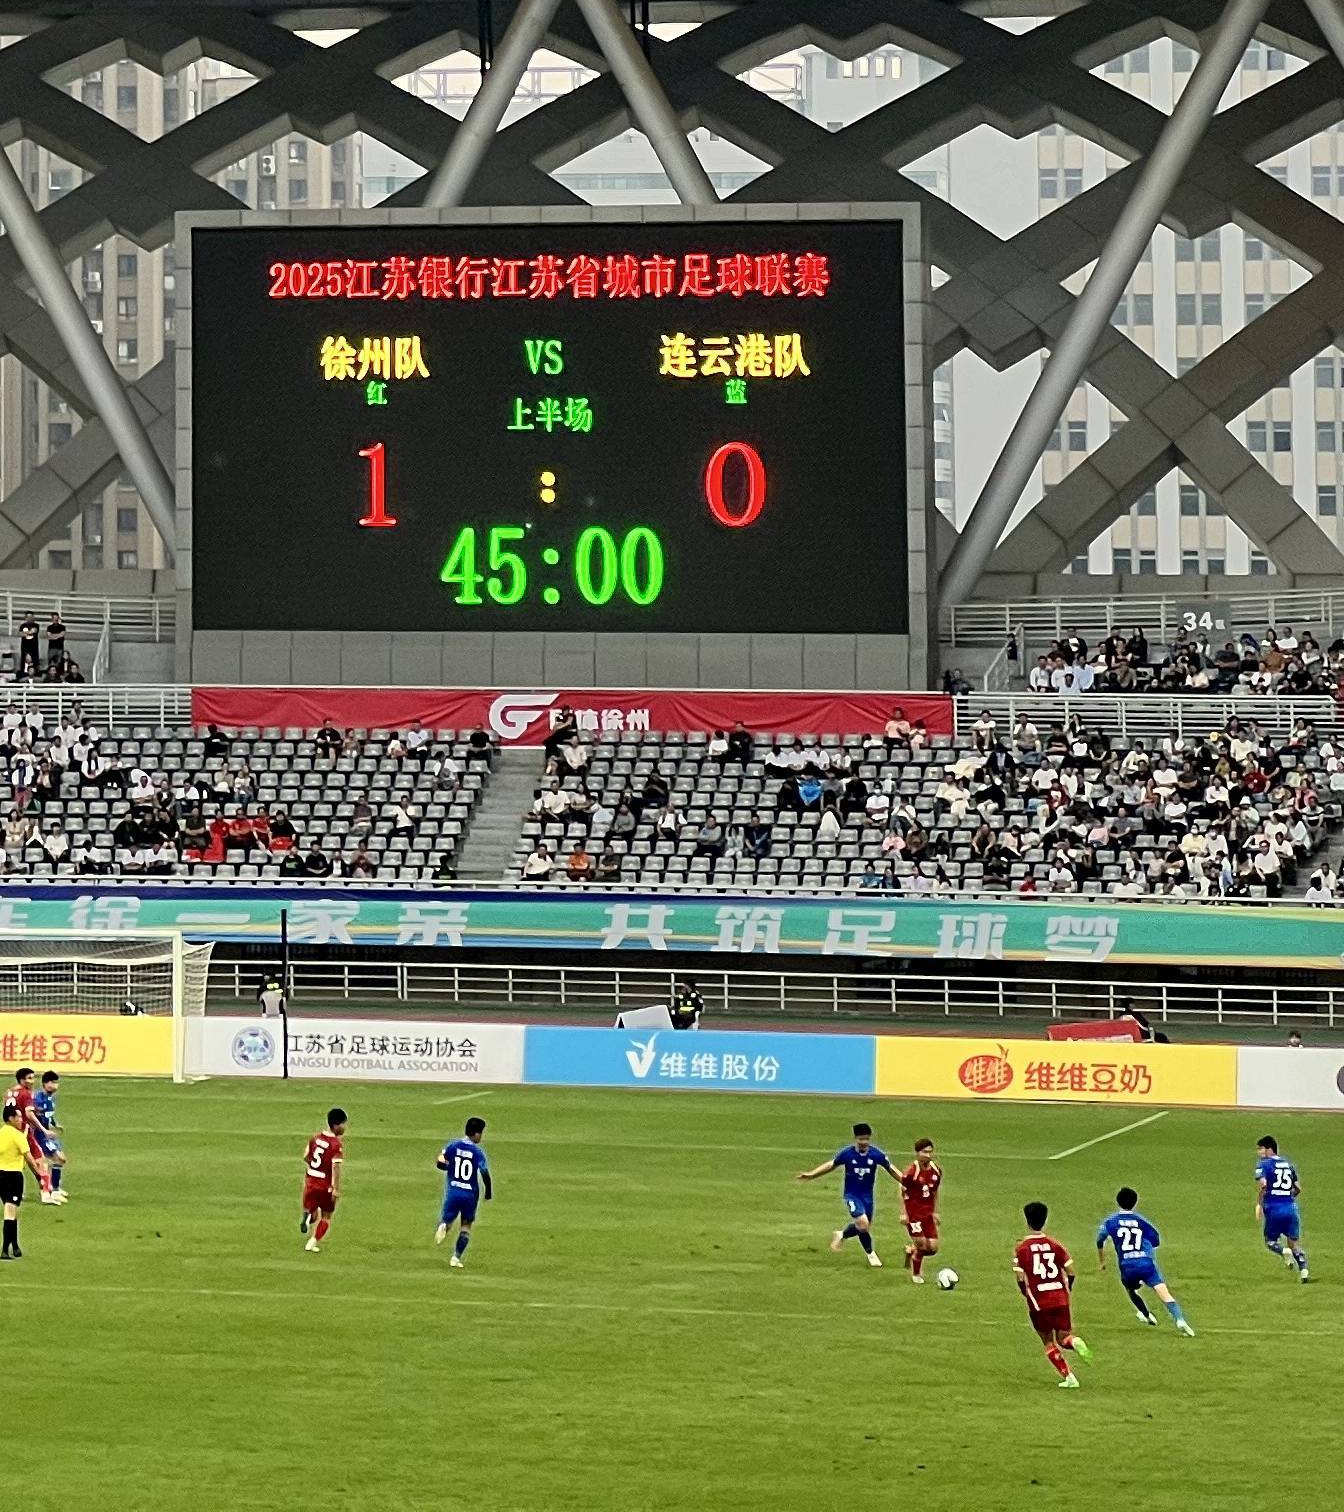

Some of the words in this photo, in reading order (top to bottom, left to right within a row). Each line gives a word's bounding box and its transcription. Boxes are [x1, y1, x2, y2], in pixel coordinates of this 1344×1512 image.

[268, 251, 831, 301] 2025江苏银行江苏省城市足球联赛
[320, 335, 430, 380] 徐州队
[524, 339, 563, 375] VS
[659, 332, 810, 379] 连云港队
[366, 380, 388, 406] 红
[725, 379, 748, 404] 蓝
[506, 397, 593, 433] 上半场
[358, 442, 397, 527] 1
[705, 441, 767, 528] 0
[441, 526, 664, 605] 45:00
[601, 903, 1120, 962] 共筑足球梦
[288, 1056, 332, 1069] ANGSU
[334, 1057, 394, 1071] FOOTBALL
[397, 1060, 479, 1073] ASSOCIATION
[660, 1051, 780, 1081] 维维股份
[1024, 1060, 1153, 1095] 维维豆奶
[310, 1147, 325, 1168] 5
[454, 1156, 472, 1181] 10
[1273, 1168, 1292, 1189] 35
[1117, 1227, 1143, 1251] 27
[1032, 1253, 1059, 1280] 43
